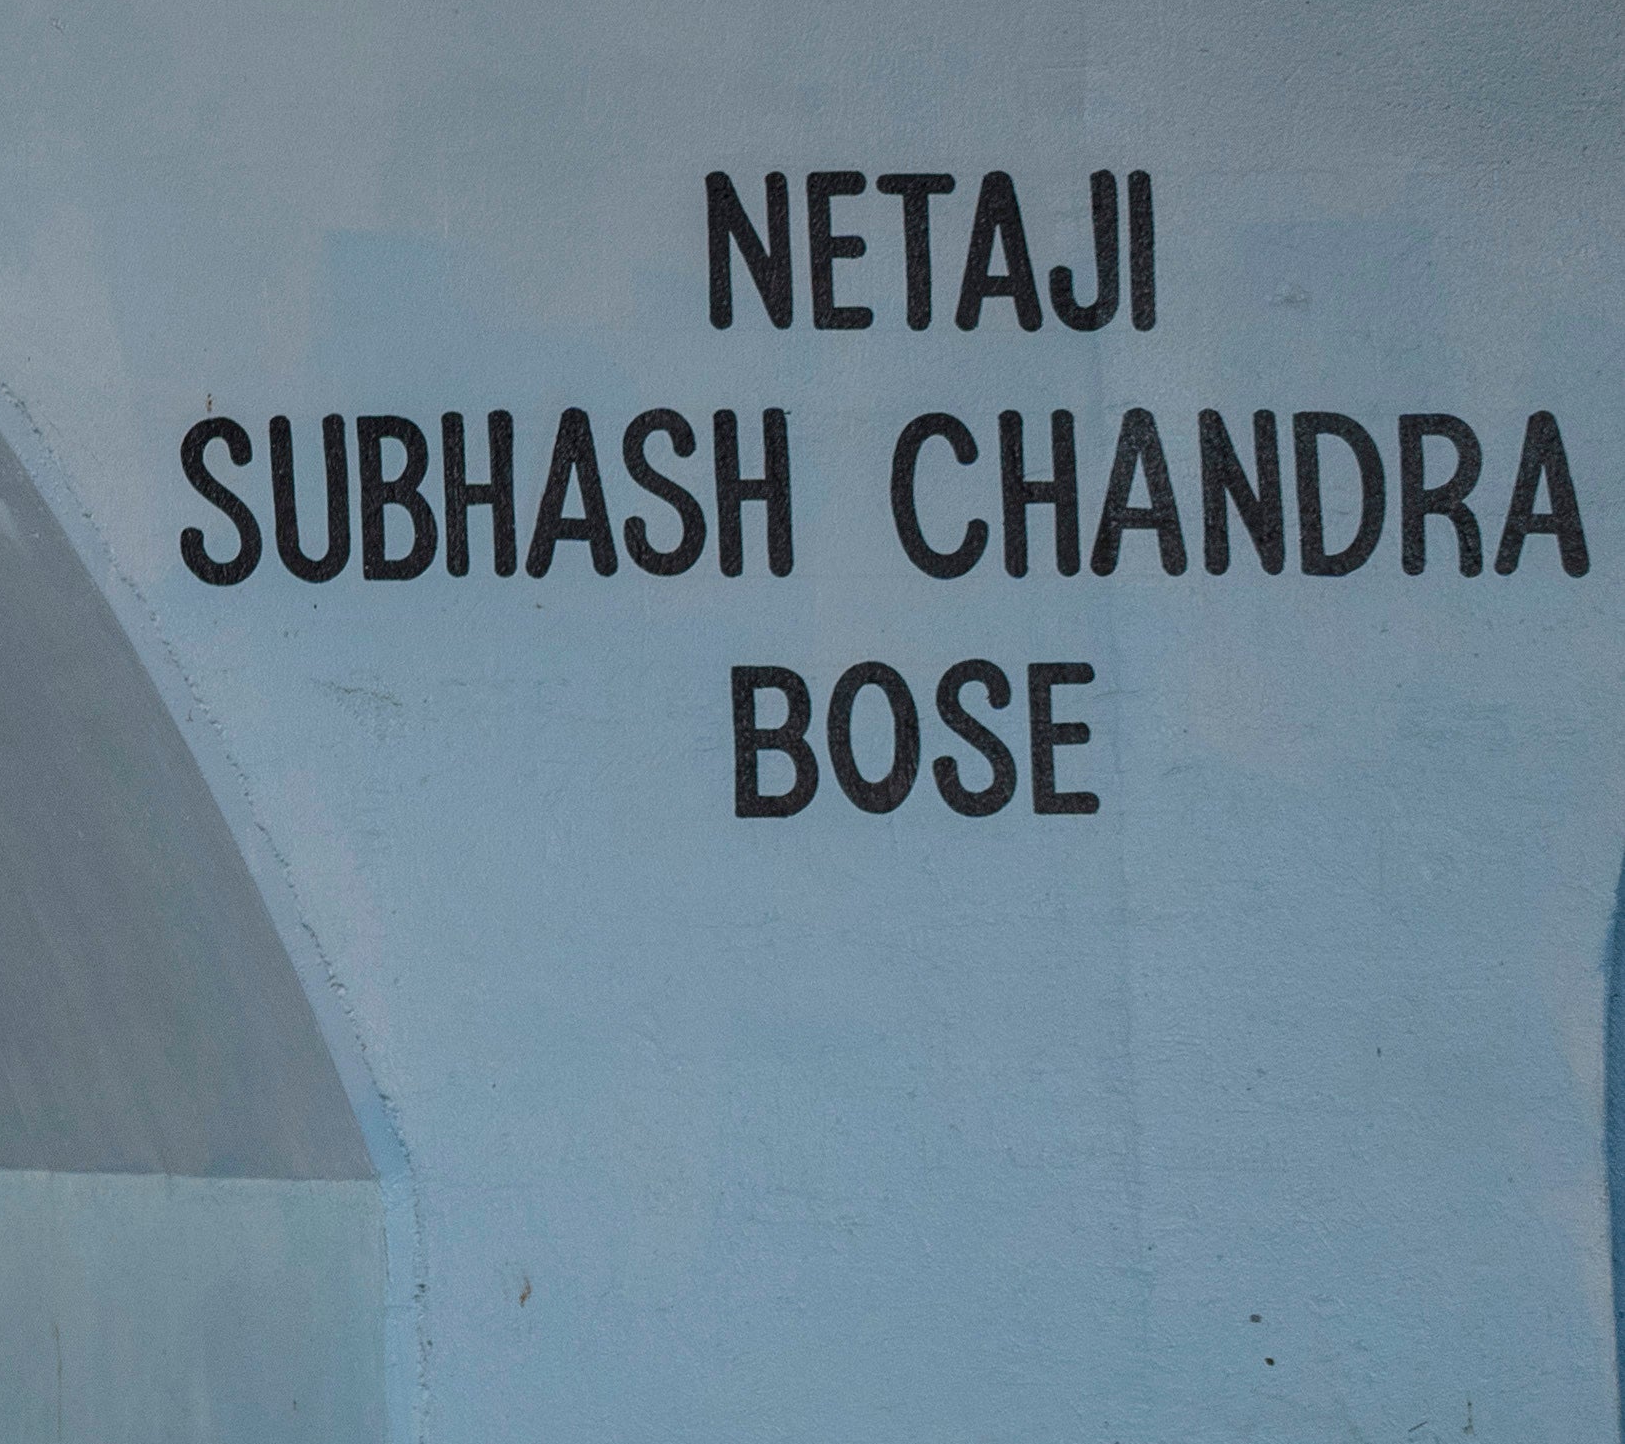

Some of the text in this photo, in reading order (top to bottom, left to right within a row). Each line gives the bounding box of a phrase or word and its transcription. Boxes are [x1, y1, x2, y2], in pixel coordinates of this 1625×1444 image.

[704, 169, 1157, 332] NETAJI
[179, 406, 1591, 586] SUBHASH CHANDRA
[733, 659, 1101, 818] BOSE
